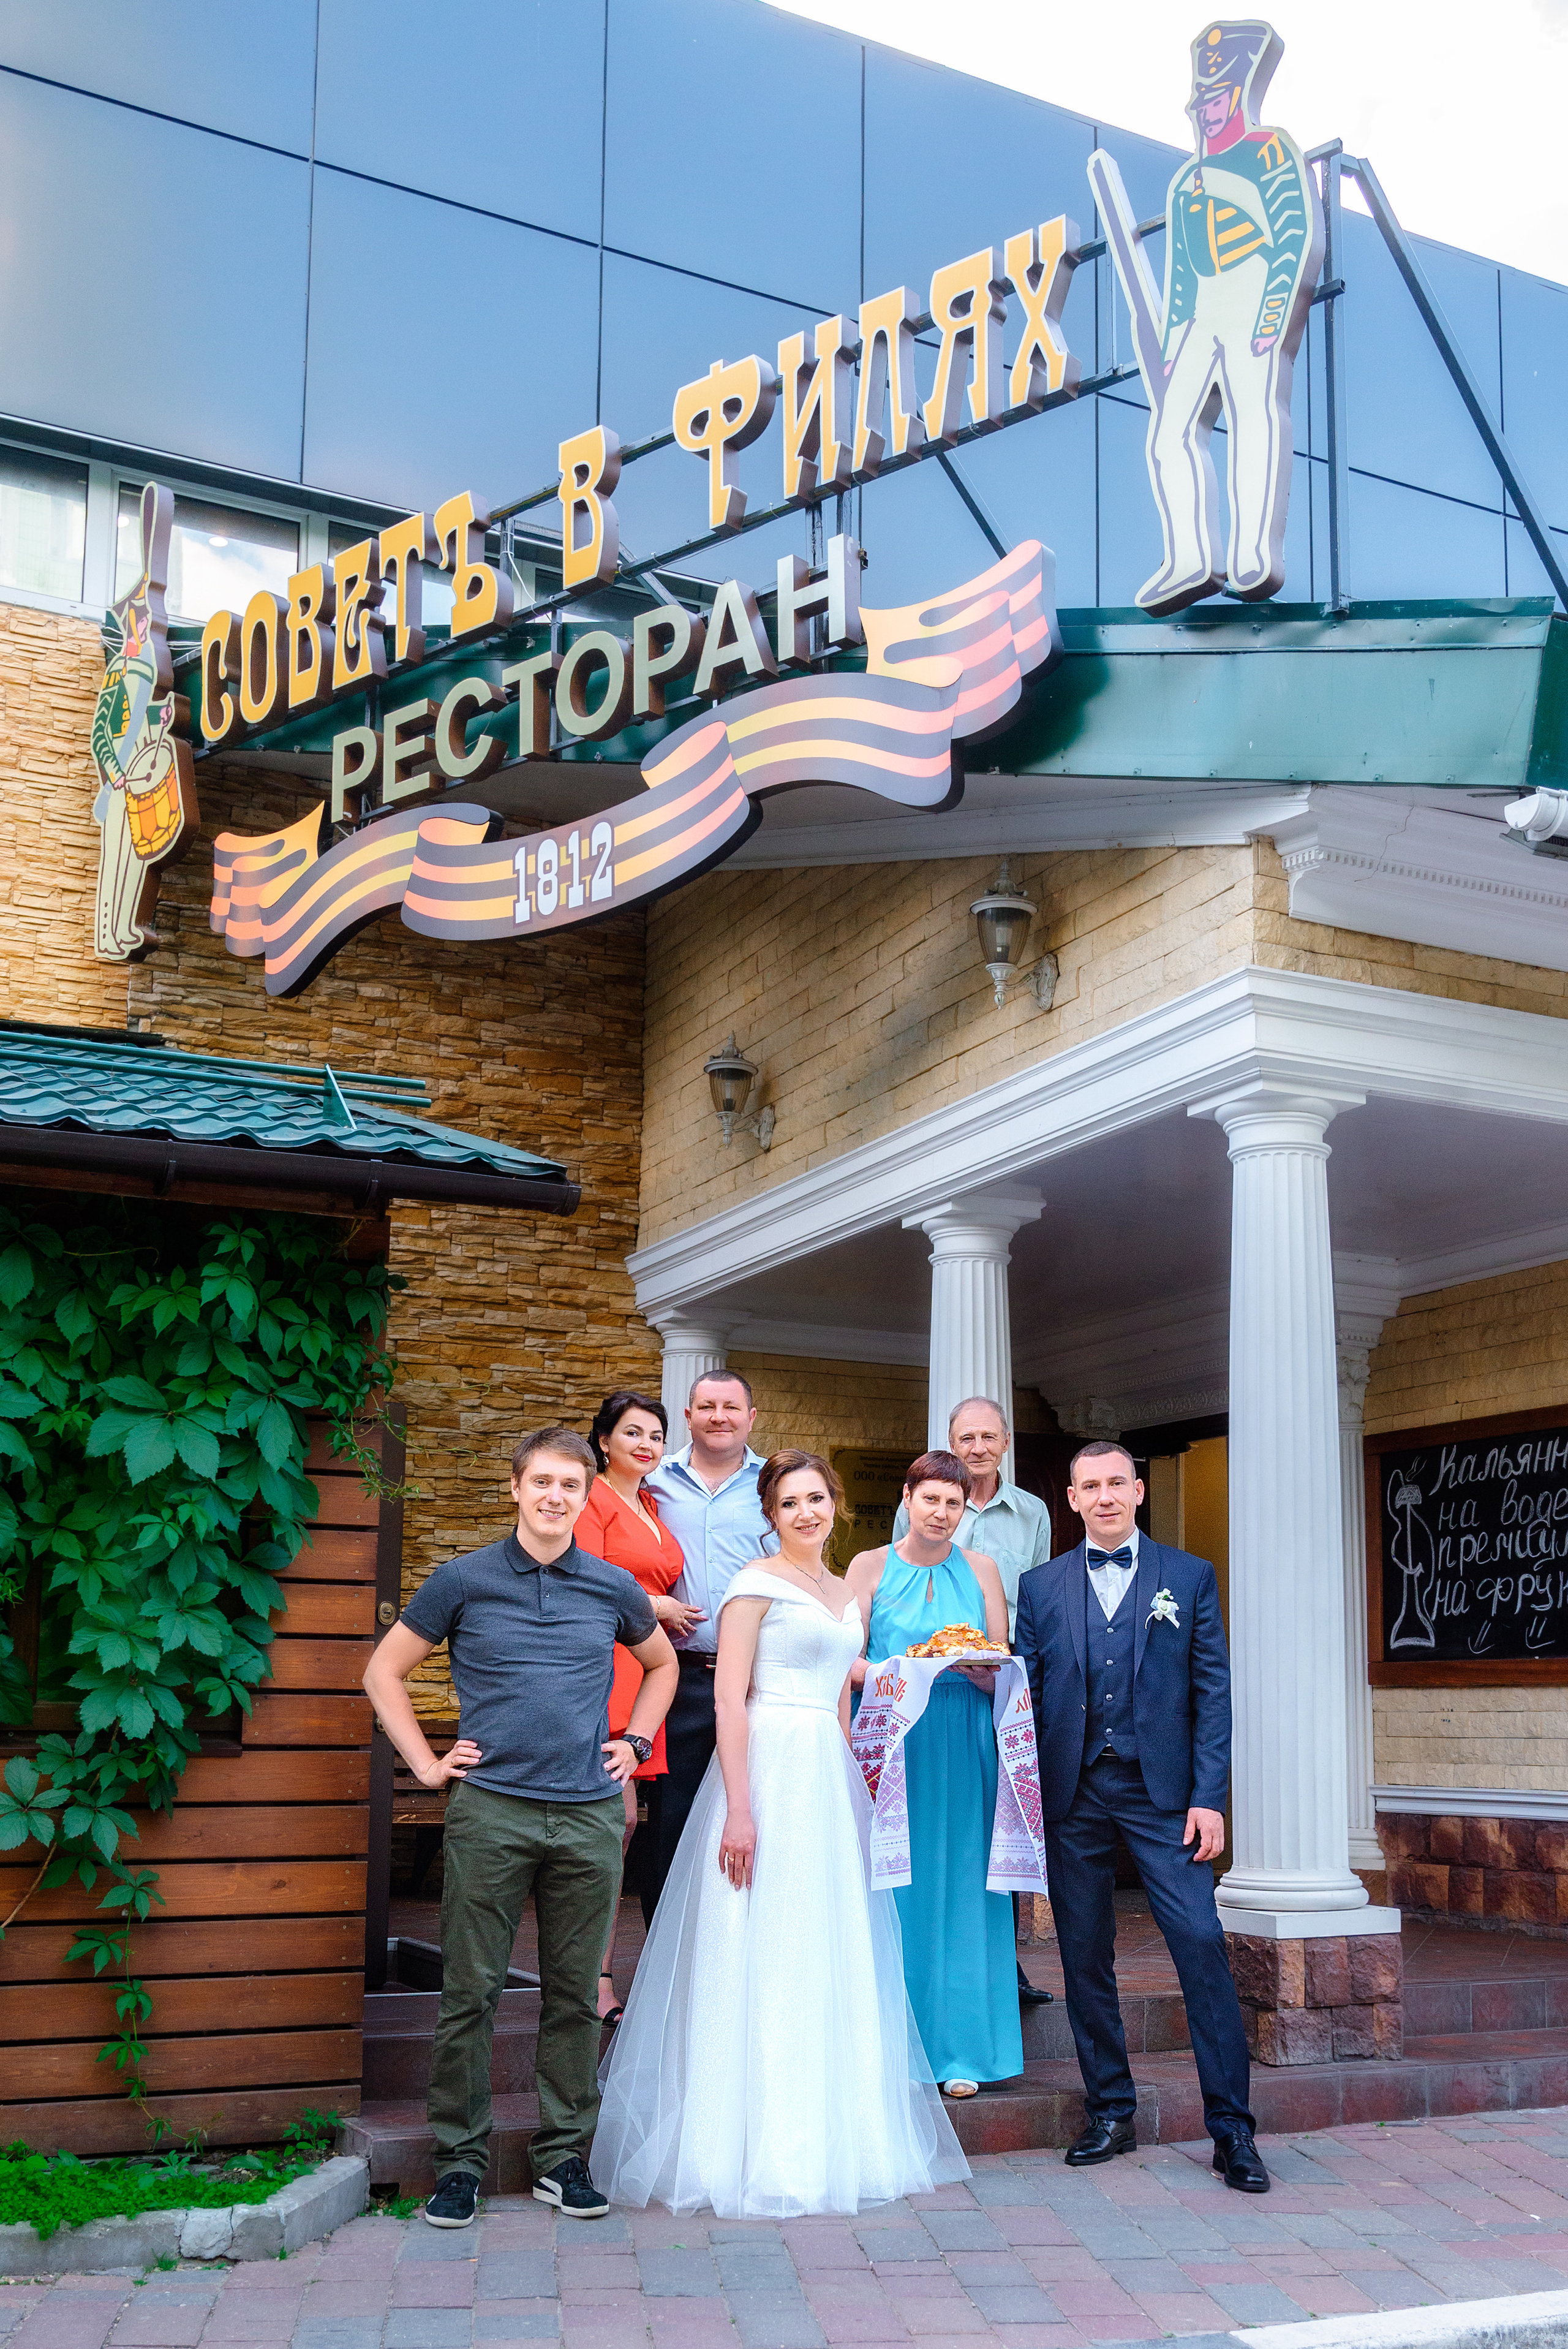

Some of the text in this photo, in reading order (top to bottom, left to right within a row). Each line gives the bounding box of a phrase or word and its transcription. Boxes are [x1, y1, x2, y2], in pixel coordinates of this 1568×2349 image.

[558, 424, 622, 596] В
[673, 213, 1083, 536] ФИЛЯХ
[331, 532, 864, 825] РЕСТОРАН
[512, 820, 614, 925] 1812
[1439, 1499, 1480, 1530] на
[1431, 1578, 1470, 1622] на
